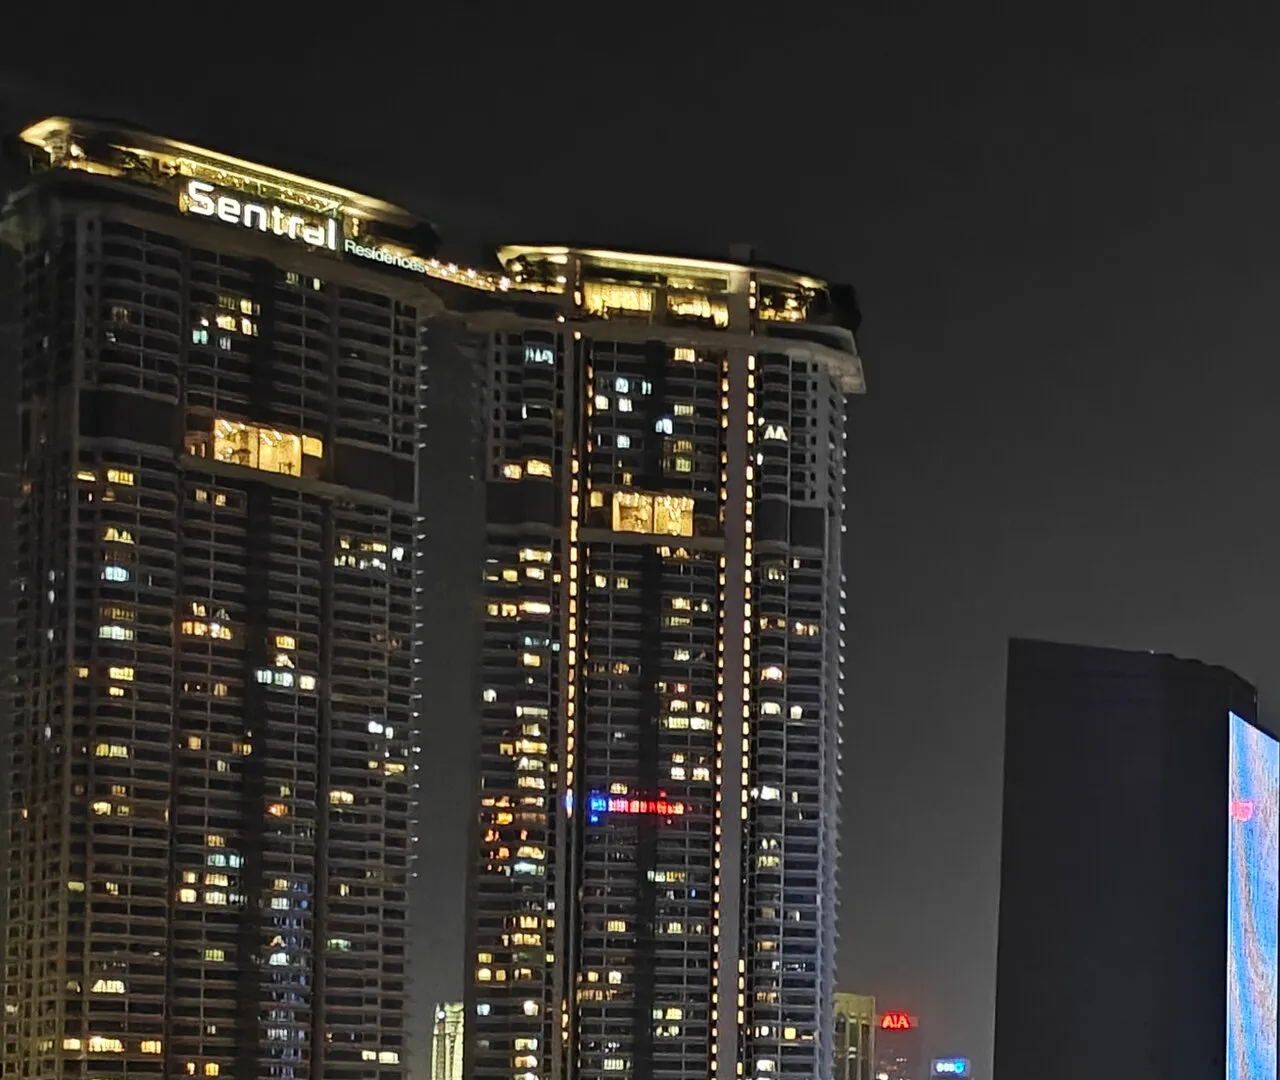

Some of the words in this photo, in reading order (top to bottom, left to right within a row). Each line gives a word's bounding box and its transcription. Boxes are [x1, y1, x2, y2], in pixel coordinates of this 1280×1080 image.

[187, 180, 337, 251] Sentral
[343, 239, 426, 274] Residences
[882, 1014, 910, 1029] AIA
